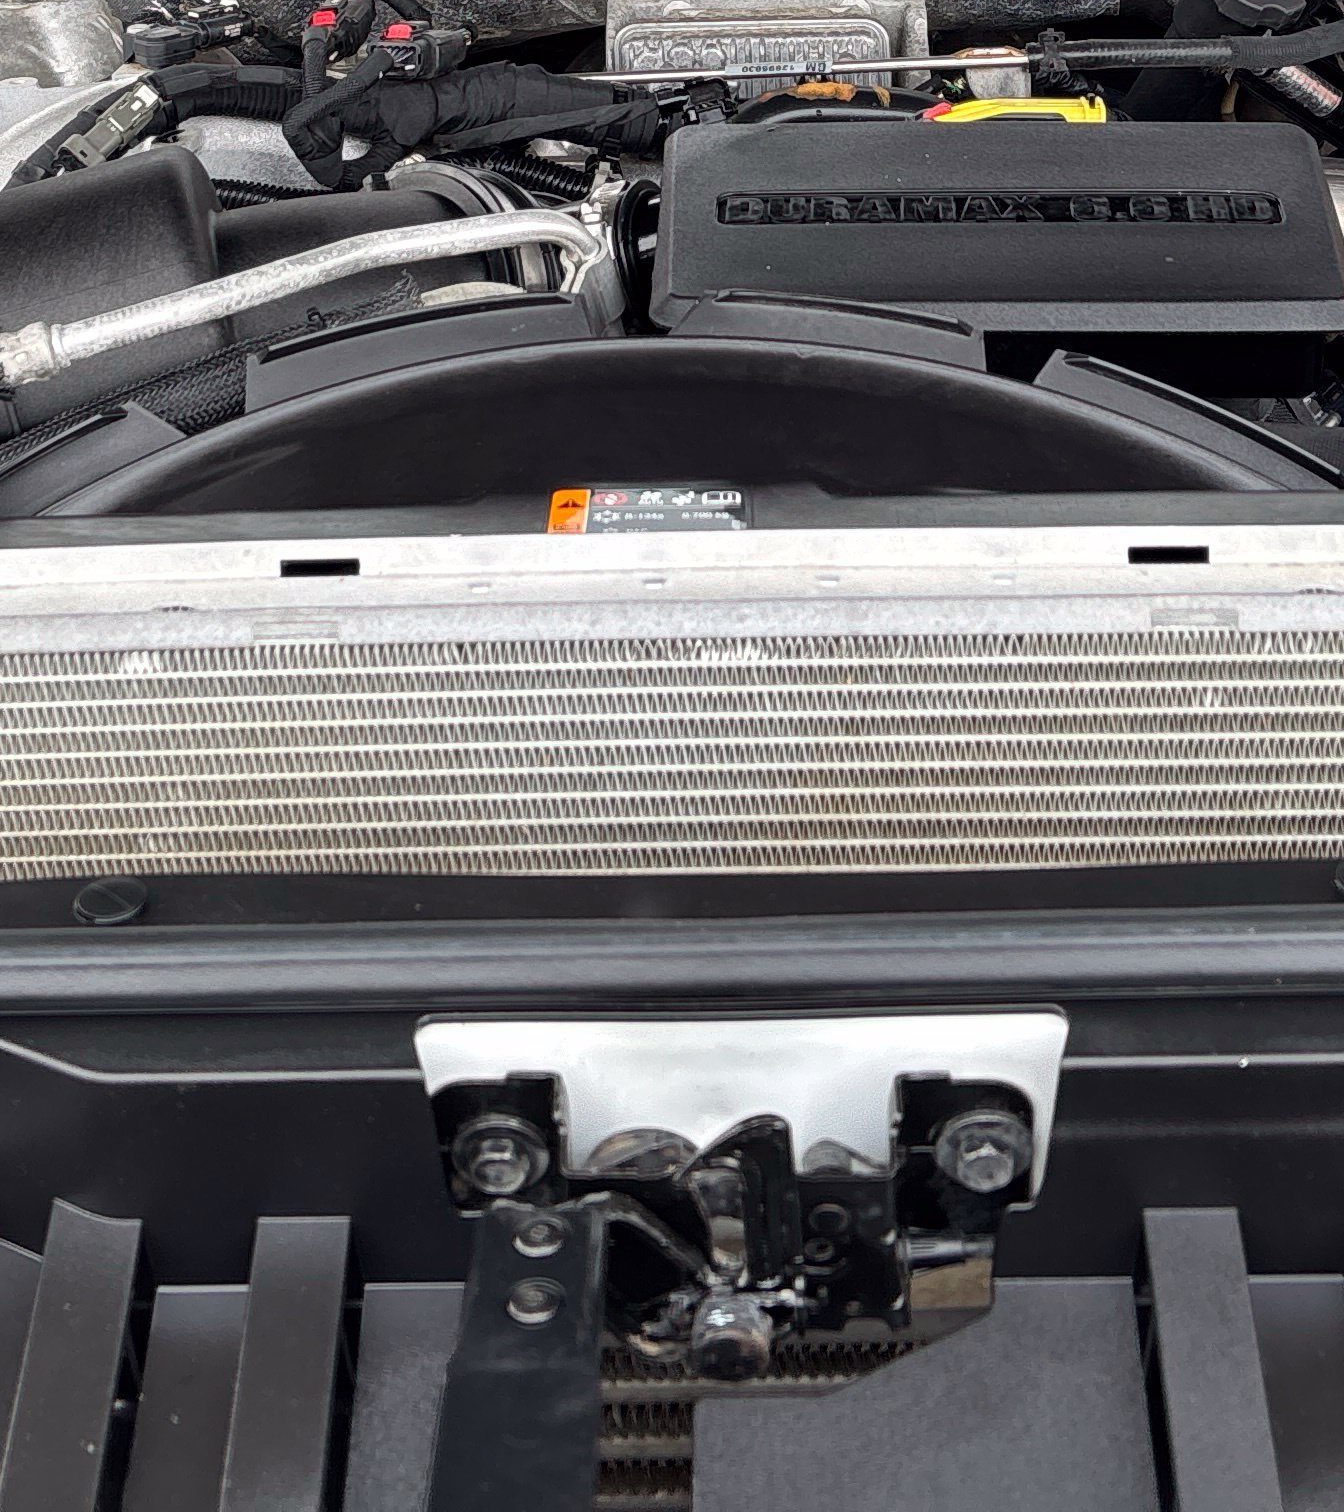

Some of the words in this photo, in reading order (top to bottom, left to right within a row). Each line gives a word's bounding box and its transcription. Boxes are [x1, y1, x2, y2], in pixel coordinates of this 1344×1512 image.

[724, 194, 1045, 223] DURAMAX
[1069, 194, 1172, 222] 6.6
[1186, 194, 1275, 224] HD
